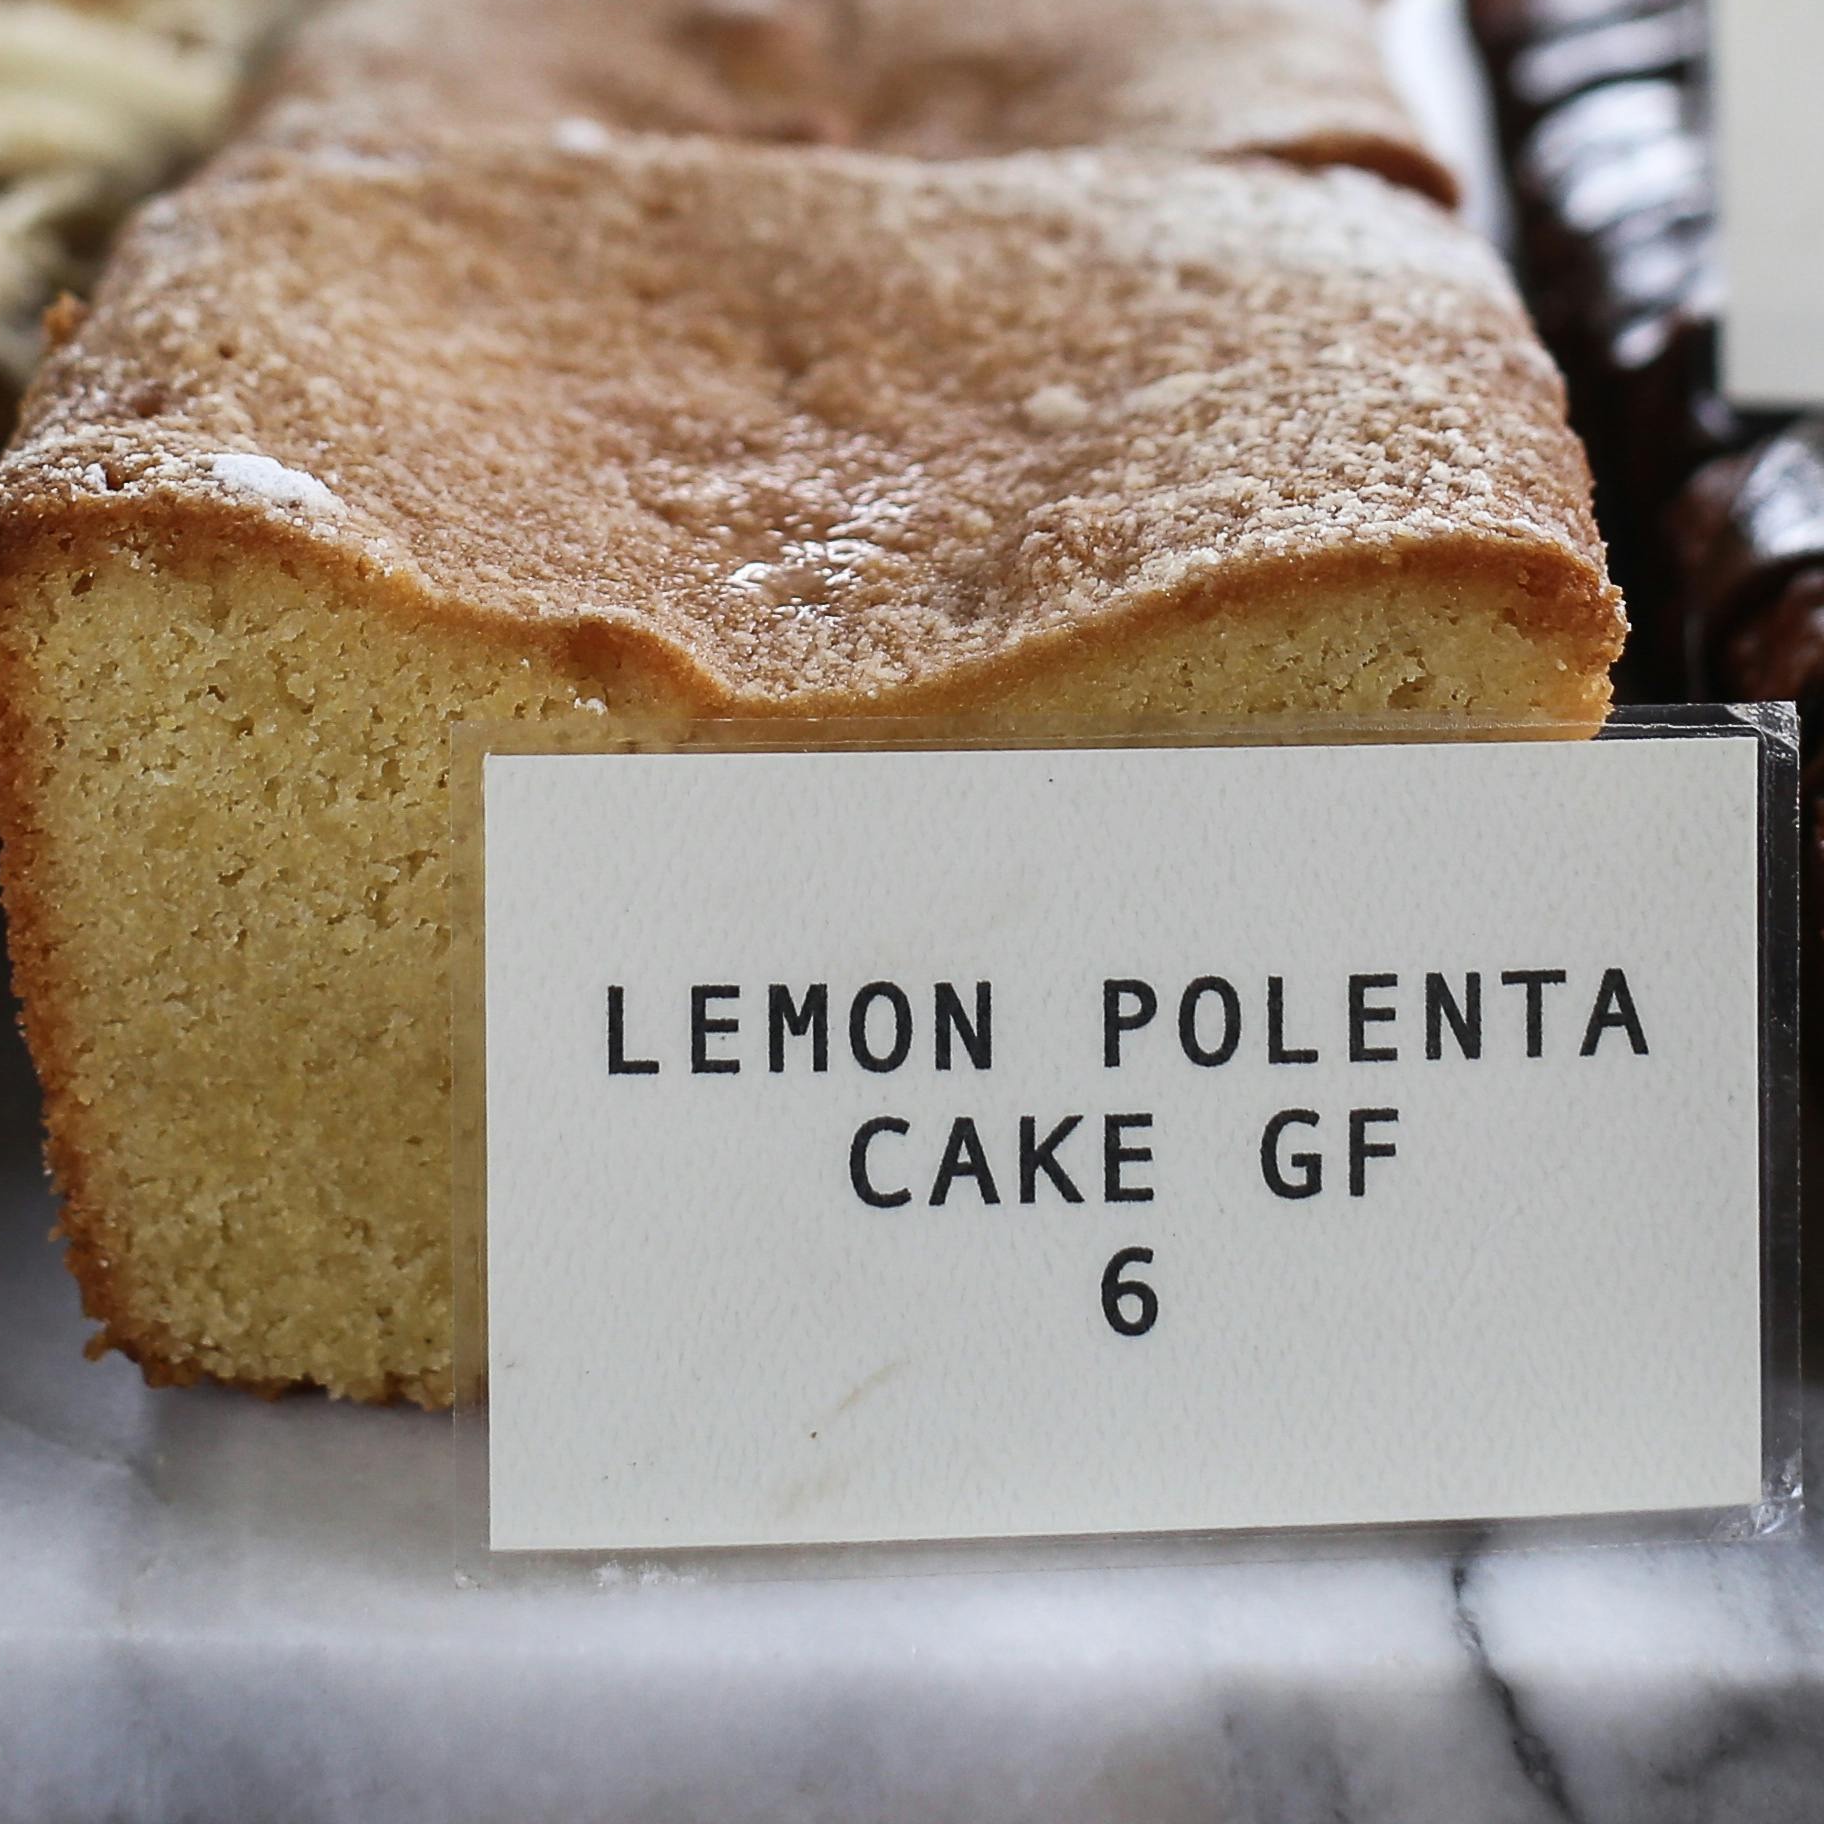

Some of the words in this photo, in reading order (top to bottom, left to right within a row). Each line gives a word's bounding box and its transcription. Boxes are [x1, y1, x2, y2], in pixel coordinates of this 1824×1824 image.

[606, 979, 993, 1077] LEMON
[1102, 966, 1651, 1070] POLENTA
[847, 1111, 1157, 1210] CAKE
[1258, 1107, 1400, 1202] GF
[1099, 1245, 1160, 1338] 6
